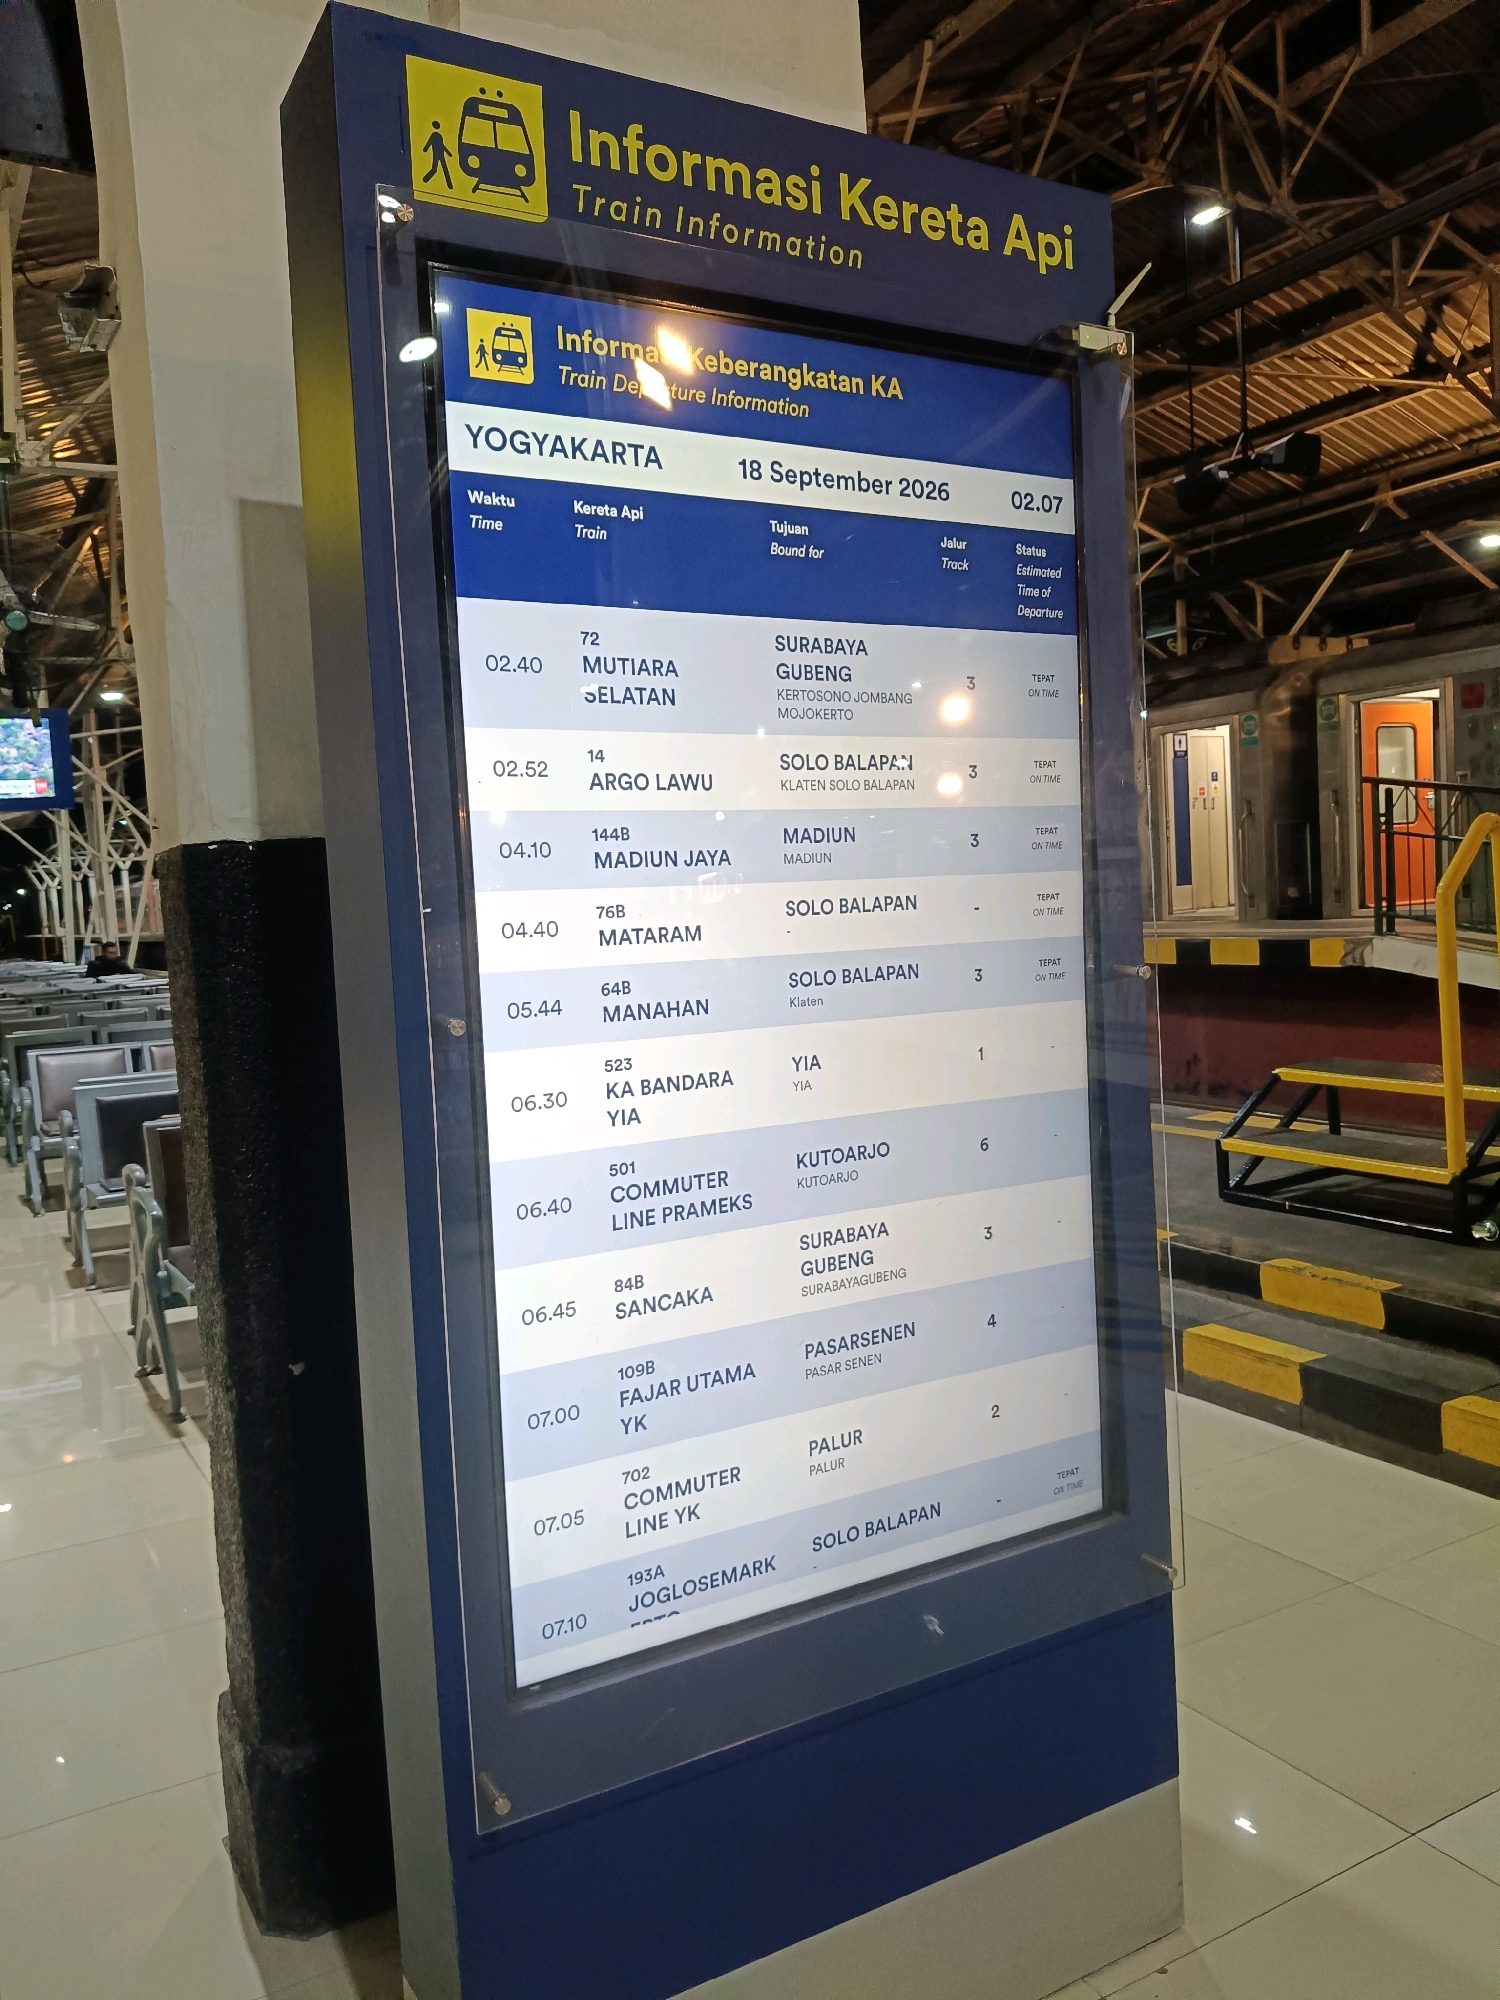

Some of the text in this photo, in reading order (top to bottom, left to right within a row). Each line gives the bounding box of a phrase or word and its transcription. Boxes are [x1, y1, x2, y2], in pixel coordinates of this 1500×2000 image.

[569, 110, 1074, 275] Informasi Kereta Api
[573, 184, 863, 269] Train Information
[691, 346, 864, 395] Keberangkatan
[871, 375, 904, 400] KA
[559, 365, 606, 390] Train
[711, 387, 810, 418] Information
[465, 423, 664, 470] YOGYAKARTA
[738, 458, 950, 501] 18 September 2026
[467, 489, 516, 508] Waktu
[1011, 490, 1063, 514] 02.07
[573, 500, 644, 522] Kereta Api
[470, 515, 503, 532] Time
[575, 524, 607, 541] Train
[770, 520, 809, 537] Tujuan
[770, 542, 825, 560] Bound for
[940, 536, 967, 550] Jalur
[1016, 543, 1047, 558] Status
[942, 557, 969, 571] Track
[1016, 564, 1063, 579] Estimated
[1017, 584, 1052, 598] Time of
[1017, 605, 1064, 620] Departure
[580, 631, 600, 646] 72
[775, 634, 869, 656] SURABAYA
[485, 654, 543, 674] 02.40
[582, 656, 680, 677] MUTIARA
[776, 663, 852, 682] GUBENG
[966, 676, 976, 690] 3
[1032, 674, 1055, 683] TEPAT
[777, 688, 913, 704] KERTOSONO JOMBANG
[1028, 689, 1060, 698] ON TIME
[777, 707, 854, 721] MOJOKERTO
[587, 749, 605, 763] 14
[779, 753, 913, 771] SOLO BALAPAN
[493, 760, 549, 778] 02.52
[969, 765, 978, 779] 3
[589, 773, 713, 791] ARGO LAWU
[781, 779, 915, 791] KLATEN SOLO BALAPAN
[1030, 775, 1061, 783] ON TIME
[592, 827, 631, 841] 144B
[783, 827, 856, 845] MADIUN
[970, 834, 979, 847] 3
[1035, 827, 1058, 835] TEPAT
[499, 842, 552, 859] 04.10
[1031, 841, 1063, 850] ON TIME
[594, 849, 732, 869] MADIUN JAYA
[784, 852, 832, 865] MADIUN
[785, 895, 918, 917] SOLO BALAPAN
[1036, 893, 1060, 901] TEPAT
[596, 904, 626, 919] 76B
[1033, 907, 1064, 917] ON TIME
[501, 921, 559, 939] 04.40
[599, 925, 702, 947] MATARAM
[1038, 958, 1062, 967] TEPAT
[788, 963, 919, 988] SOLO BALAPAN
[974, 968, 983, 982] 3
[1035, 972, 1066, 982] ON TIME
[601, 980, 631, 996] 64B
[507, 1000, 563, 1020] 05.44
[603, 999, 710, 1023] MANAHAN
[789, 996, 824, 1008] Klaten
[792, 1054, 822, 1073] YIA
[977, 1047, 985, 1061] 1
[604, 1057, 633, 1073] 523
[606, 1070, 734, 1100] KA BANDARA
[792, 1079, 813, 1092] YIA
[511, 1091, 568, 1113] 06.30
[607, 1107, 642, 1127] YIA
[980, 1137, 989, 1152] 6
[796, 1142, 891, 1169] KUTOARJO
[609, 1161, 636, 1177] 501
[610, 1170, 729, 1204] COMMUTER
[797, 1170, 859, 1190] KUTOARJO
[516, 1197, 573, 1221] 06.40
[612, 1194, 754, 1232] LINE PRAMEKS
[799, 1221, 890, 1251] SURABAYA
[983, 1226, 993, 1241] 3
[800, 1249, 875, 1277] GUBENG
[614, 1274, 645, 1293] 84B
[801, 1267, 908, 1298] SURABAYAGUBENG
[615, 1286, 714, 1321] SANCAKA
[521, 1301, 577, 1326] 06.45
[987, 1313, 997, 1328] 4
[805, 1321, 917, 1360] PASARSENEN
[617, 1360, 656, 1381] 109B
[805, 1353, 883, 1380] PASAR SENEN
[619, 1362, 757, 1408] FAJAR UTAMA
[527, 1404, 581, 1431] 07.00
[991, 1404, 1000, 1419] 2
[620, 1414, 648, 1435] YK
[809, 1429, 863, 1457] PALUR
[622, 1466, 651, 1485] 702
[809, 1457, 845, 1477] PALUR
[1056, 1466, 1081, 1480] TEPAT
[624, 1466, 742, 1510] COMMUTER
[1053, 1479, 1084, 1496] ON TIME
[533, 1509, 585, 1537] 07.05
[625, 1503, 701, 1539] LINE YK
[812, 1501, 942, 1553] SOLO BALAPAN
[626, 1564, 666, 1587] 193A
[629, 1555, 777, 1613] JOGLOSEMARK
[542, 1613, 588, 1640] 07.10
